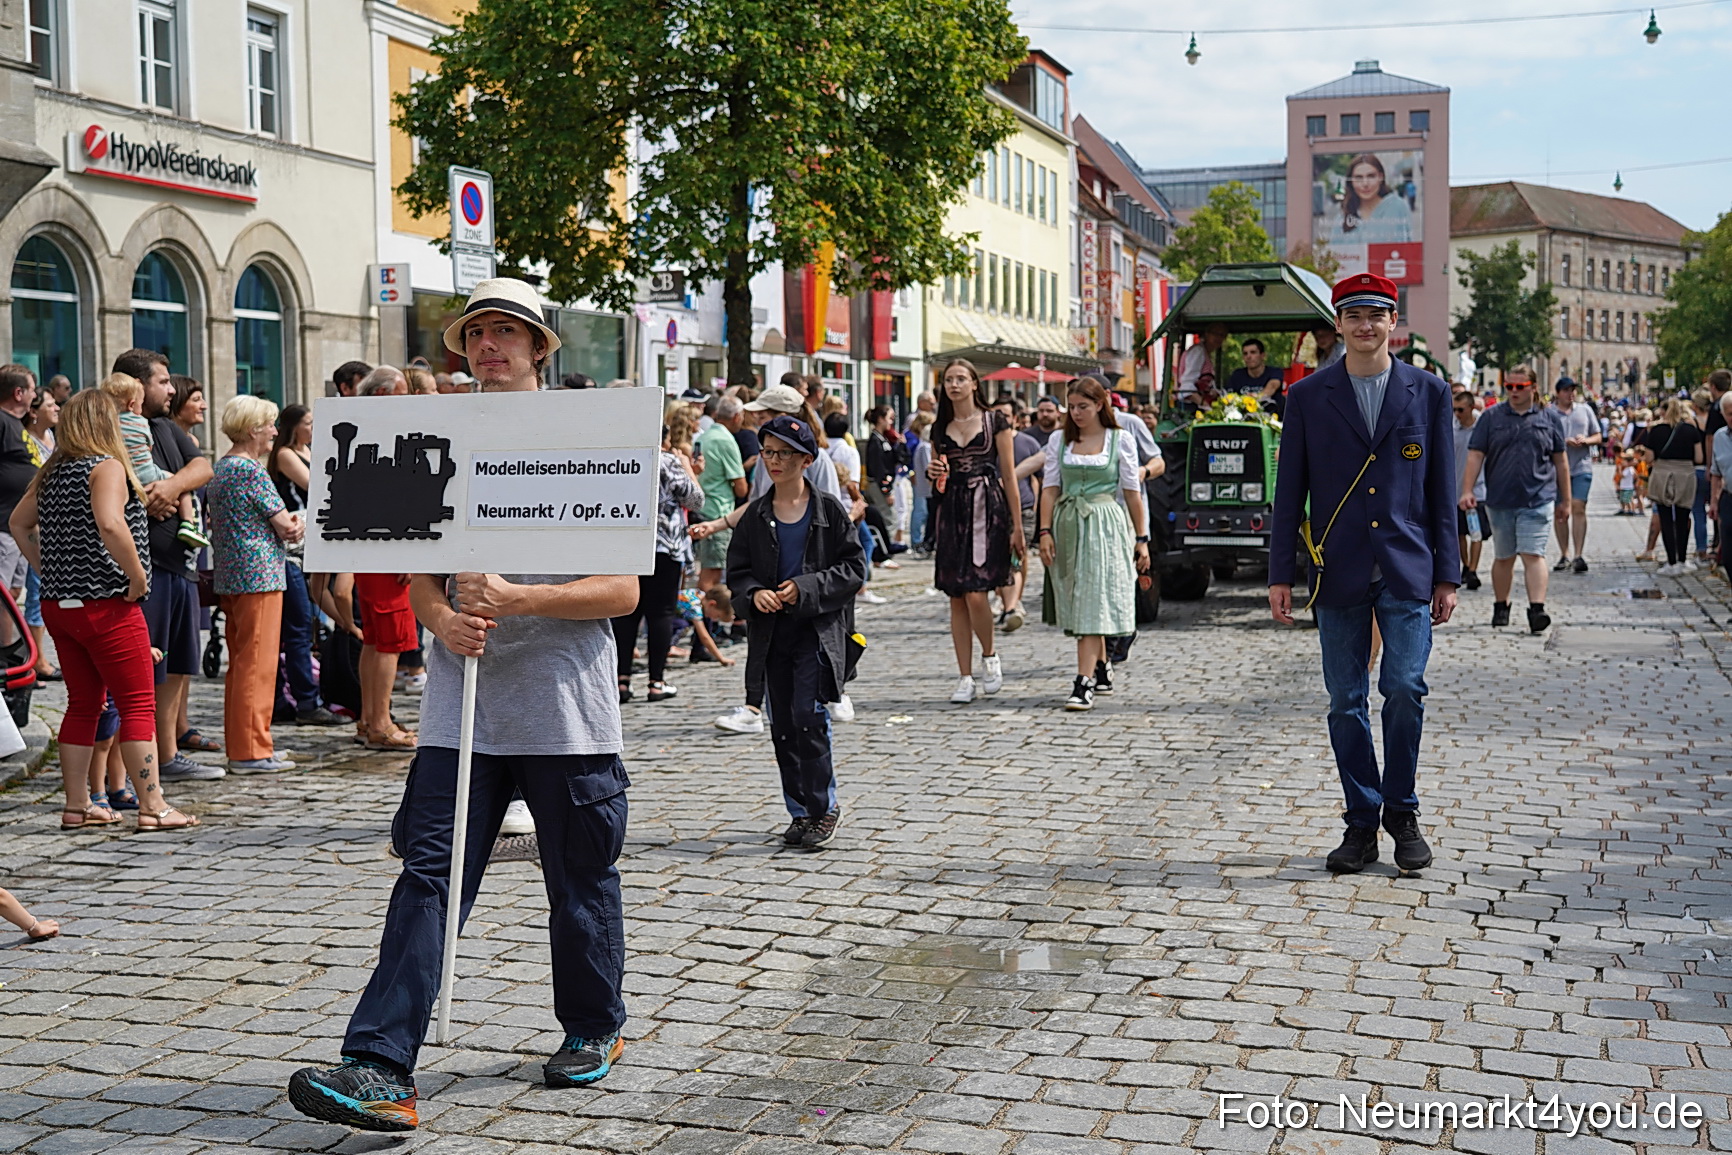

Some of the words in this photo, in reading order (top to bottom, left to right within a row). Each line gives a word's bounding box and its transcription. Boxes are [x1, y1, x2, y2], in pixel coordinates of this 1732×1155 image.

[111, 132, 257, 187] HypoVereinsbank
[464, 228, 483, 242] ZONE
[1203, 439, 1249, 450] FENDT
[475, 459, 641, 475] Modelleisenbahnclub
[477, 503, 555, 518] Neumarkt
[558, 503, 567, 521] /
[572, 503, 605, 521] Opf.
[610, 503, 640, 518] e.V.
